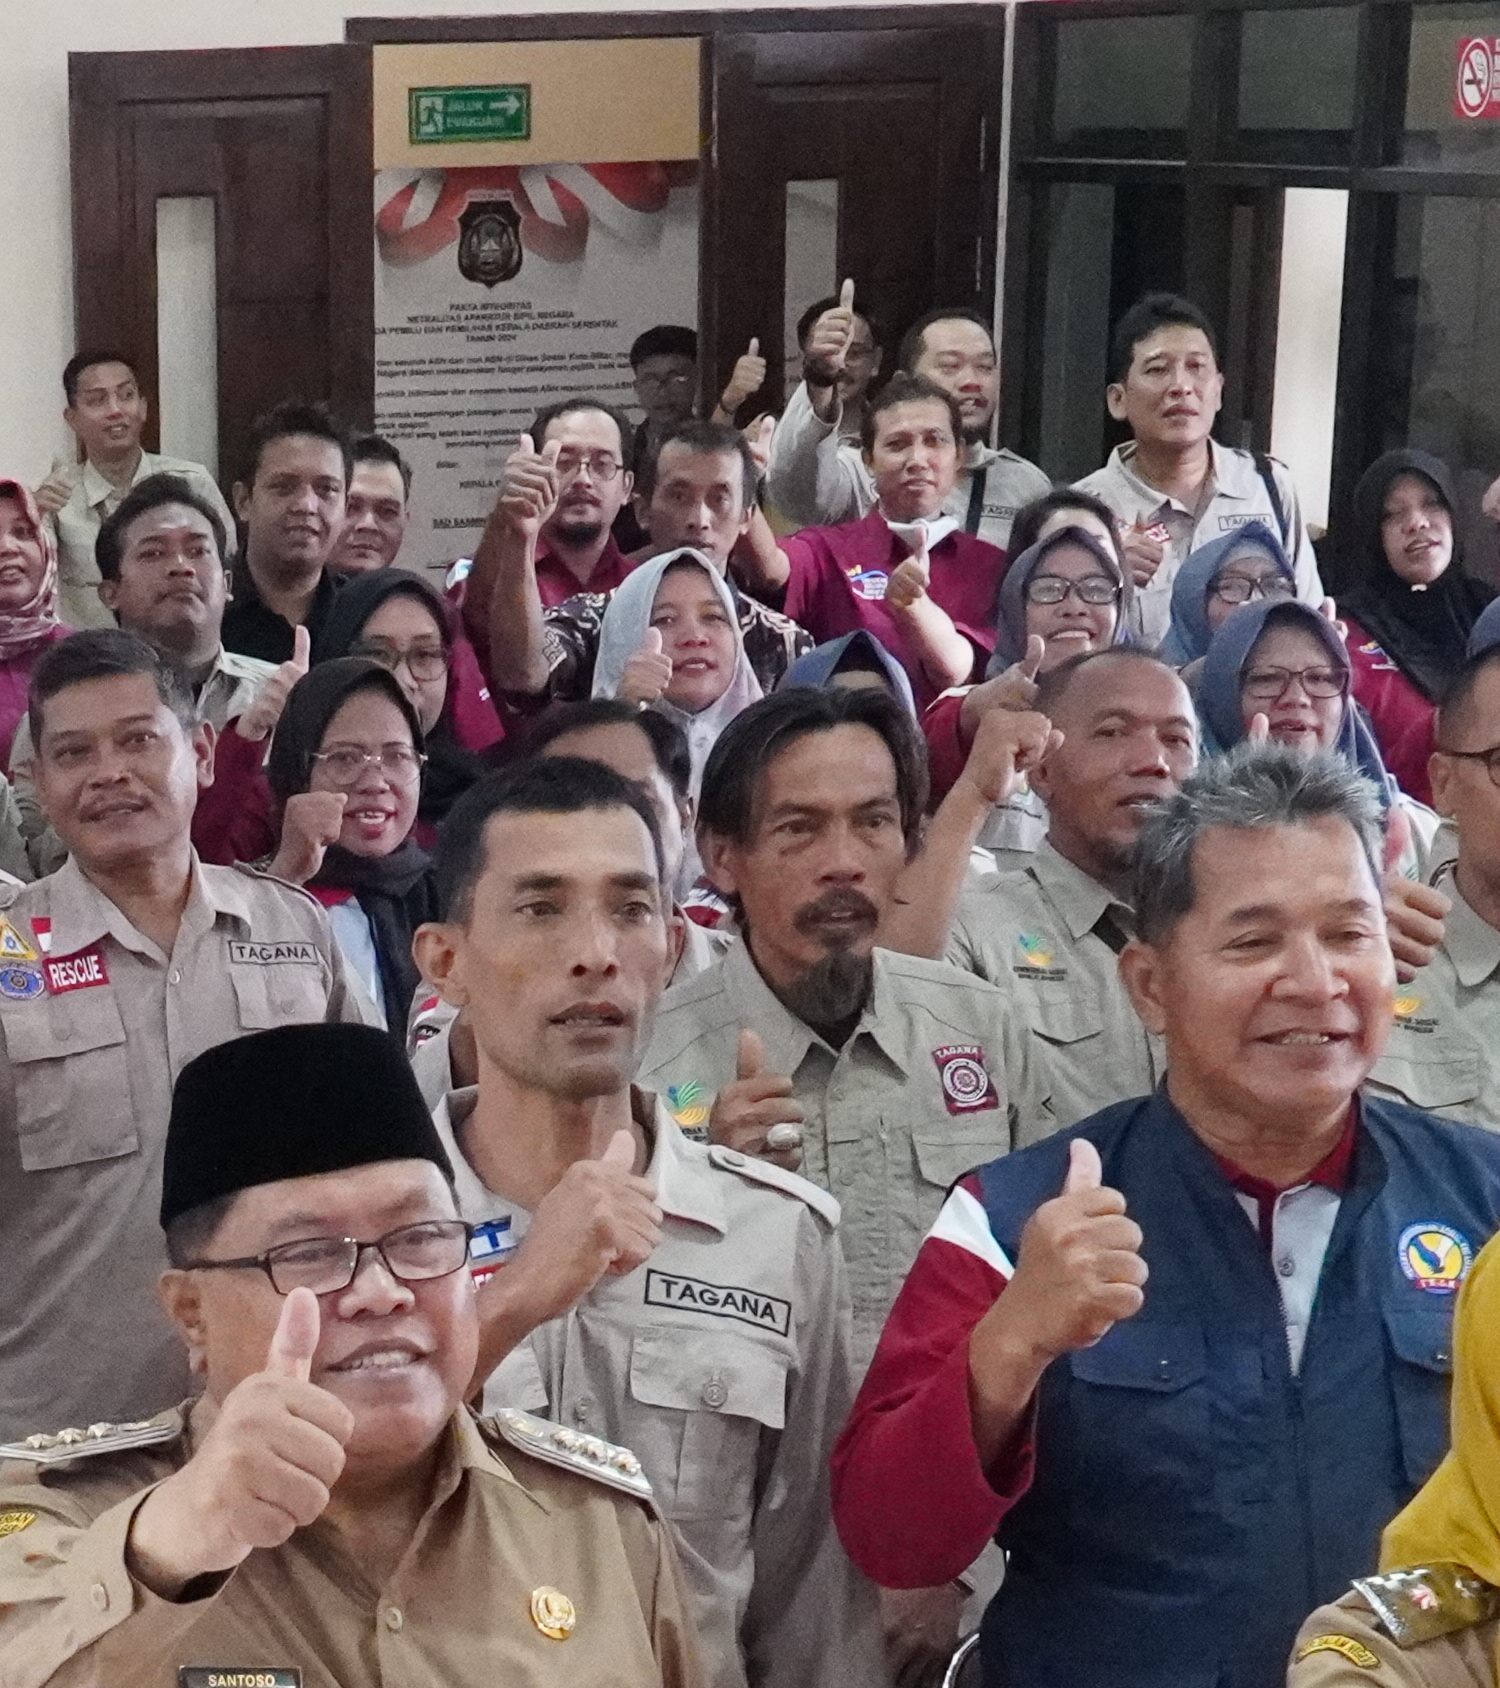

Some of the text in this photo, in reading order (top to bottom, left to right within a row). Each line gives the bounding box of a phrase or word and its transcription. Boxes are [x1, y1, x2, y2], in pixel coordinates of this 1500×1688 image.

[235, 945, 312, 961] TAGANA
[47, 954, 104, 989] RESCUE
[935, 1046, 980, 1059] TAGANA
[660, 1278, 777, 1324] TAGANA
[208, 1673, 277, 1688] SANTOSO
